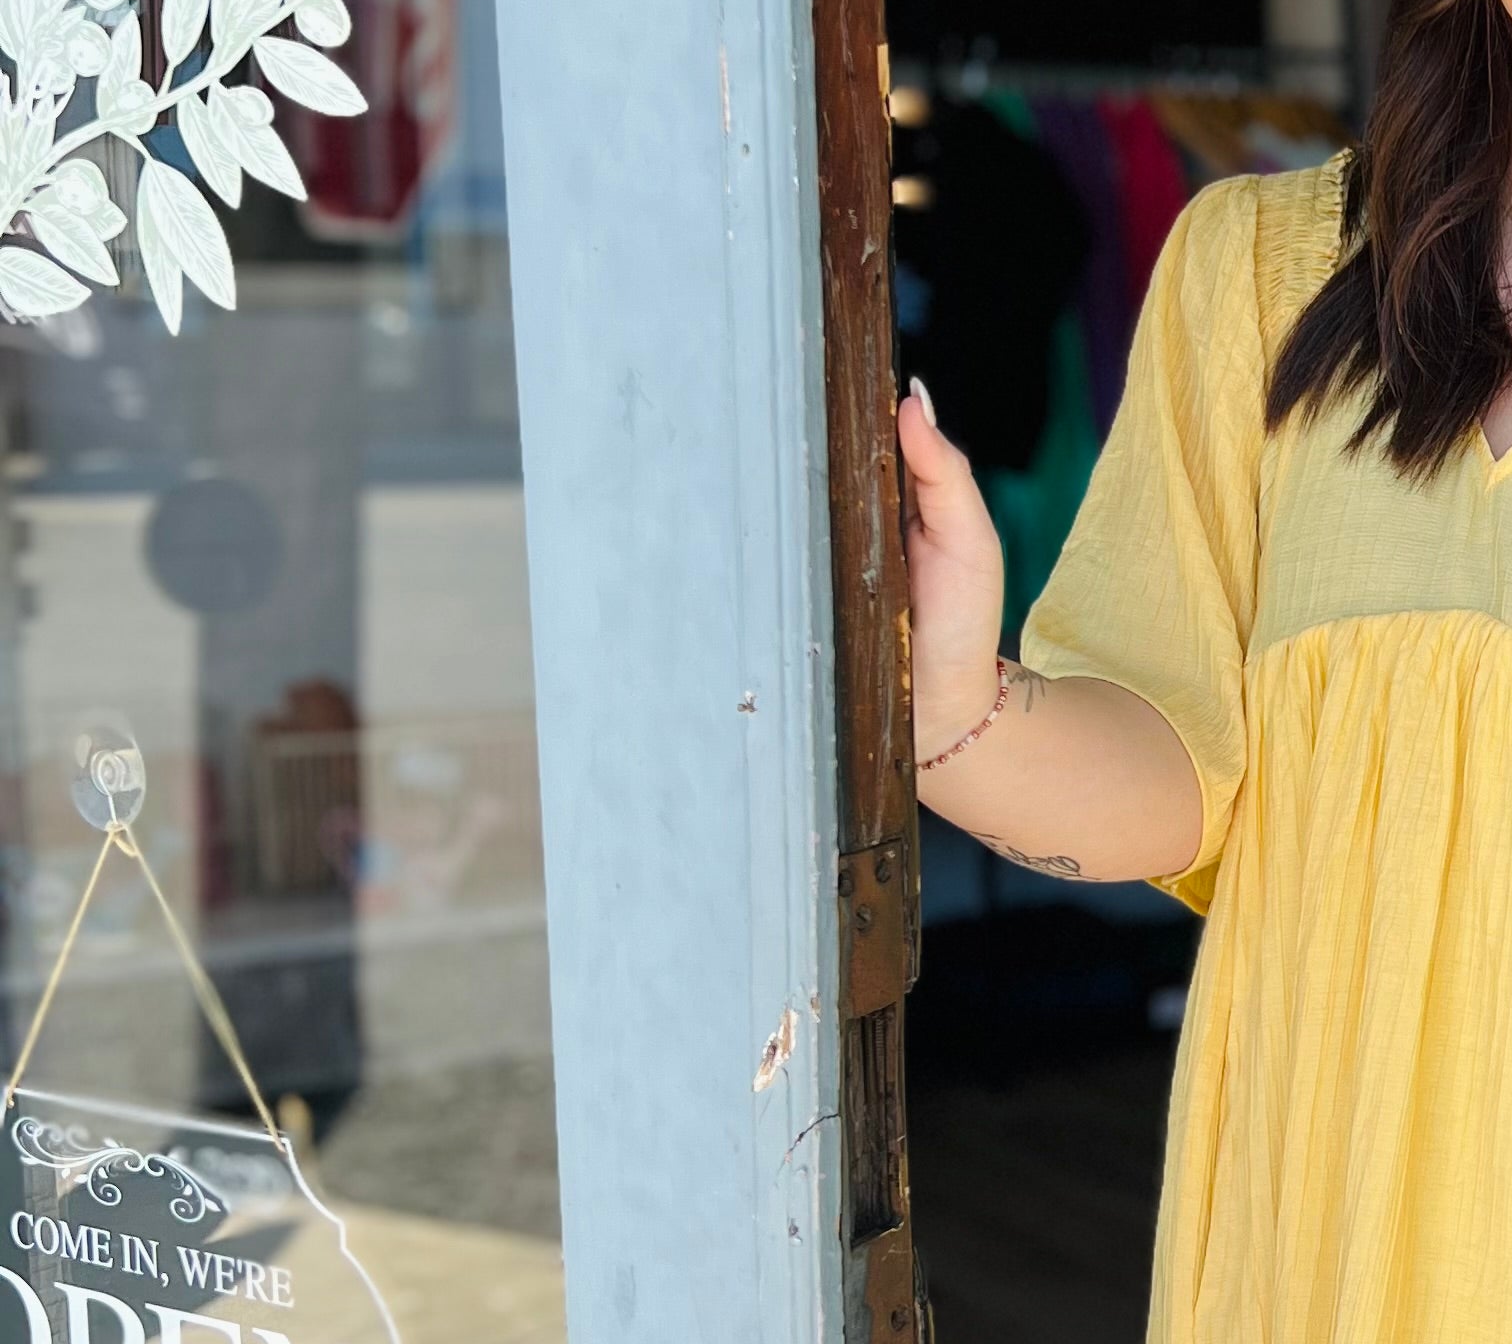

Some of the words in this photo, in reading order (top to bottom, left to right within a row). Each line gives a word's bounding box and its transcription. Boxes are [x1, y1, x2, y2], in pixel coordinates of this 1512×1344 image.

[11, 1211, 114, 1269] COME
[119, 1232, 170, 1288] IN,
[177, 1245, 295, 1308] WE'RE
